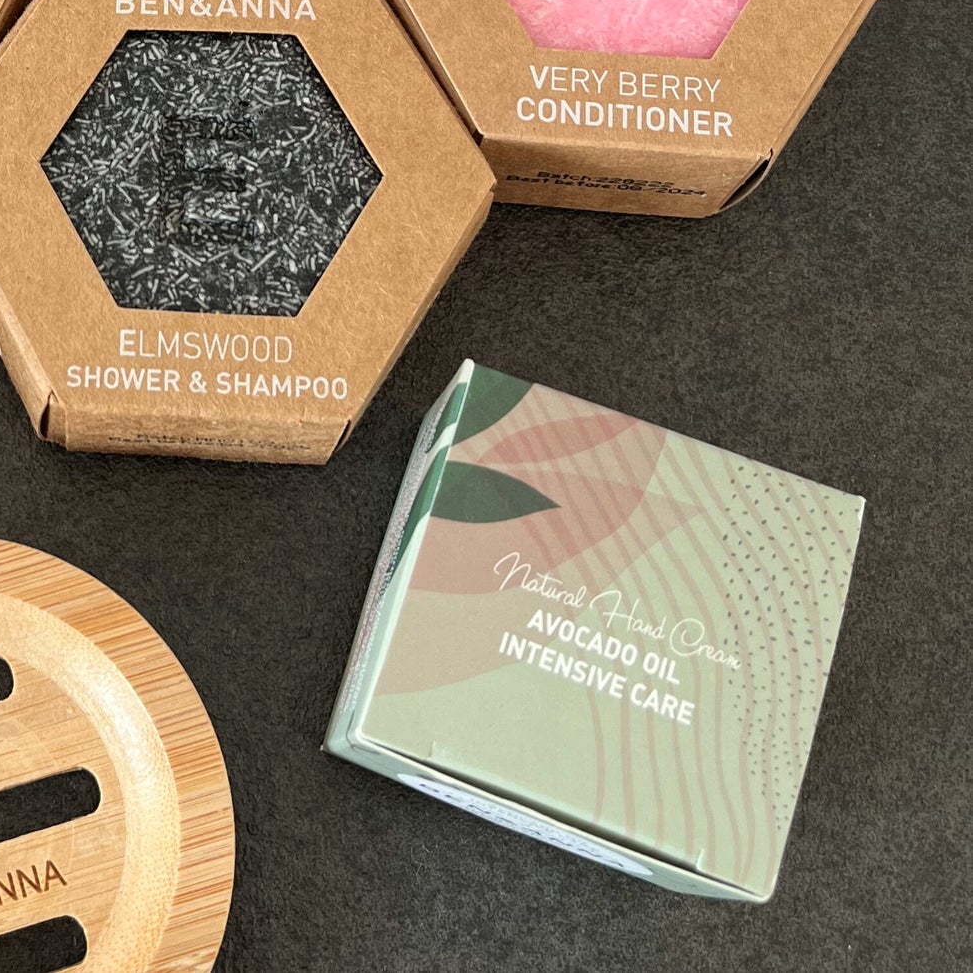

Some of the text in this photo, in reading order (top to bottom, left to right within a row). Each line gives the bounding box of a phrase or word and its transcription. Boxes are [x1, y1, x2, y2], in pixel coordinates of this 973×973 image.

[529, 65, 722, 103] VERY BERRY
[516, 96, 733, 137] CONDITIONER
[119, 329, 293, 363] ELMSWOOD
[66, 365, 348, 400] SHOWER & SHAMPOO
[493, 551, 741, 670] Natural Hand Cream
[526, 608, 680, 685] AVOCADO OIL
[498, 631, 695, 726] INTENSIVE CARE
